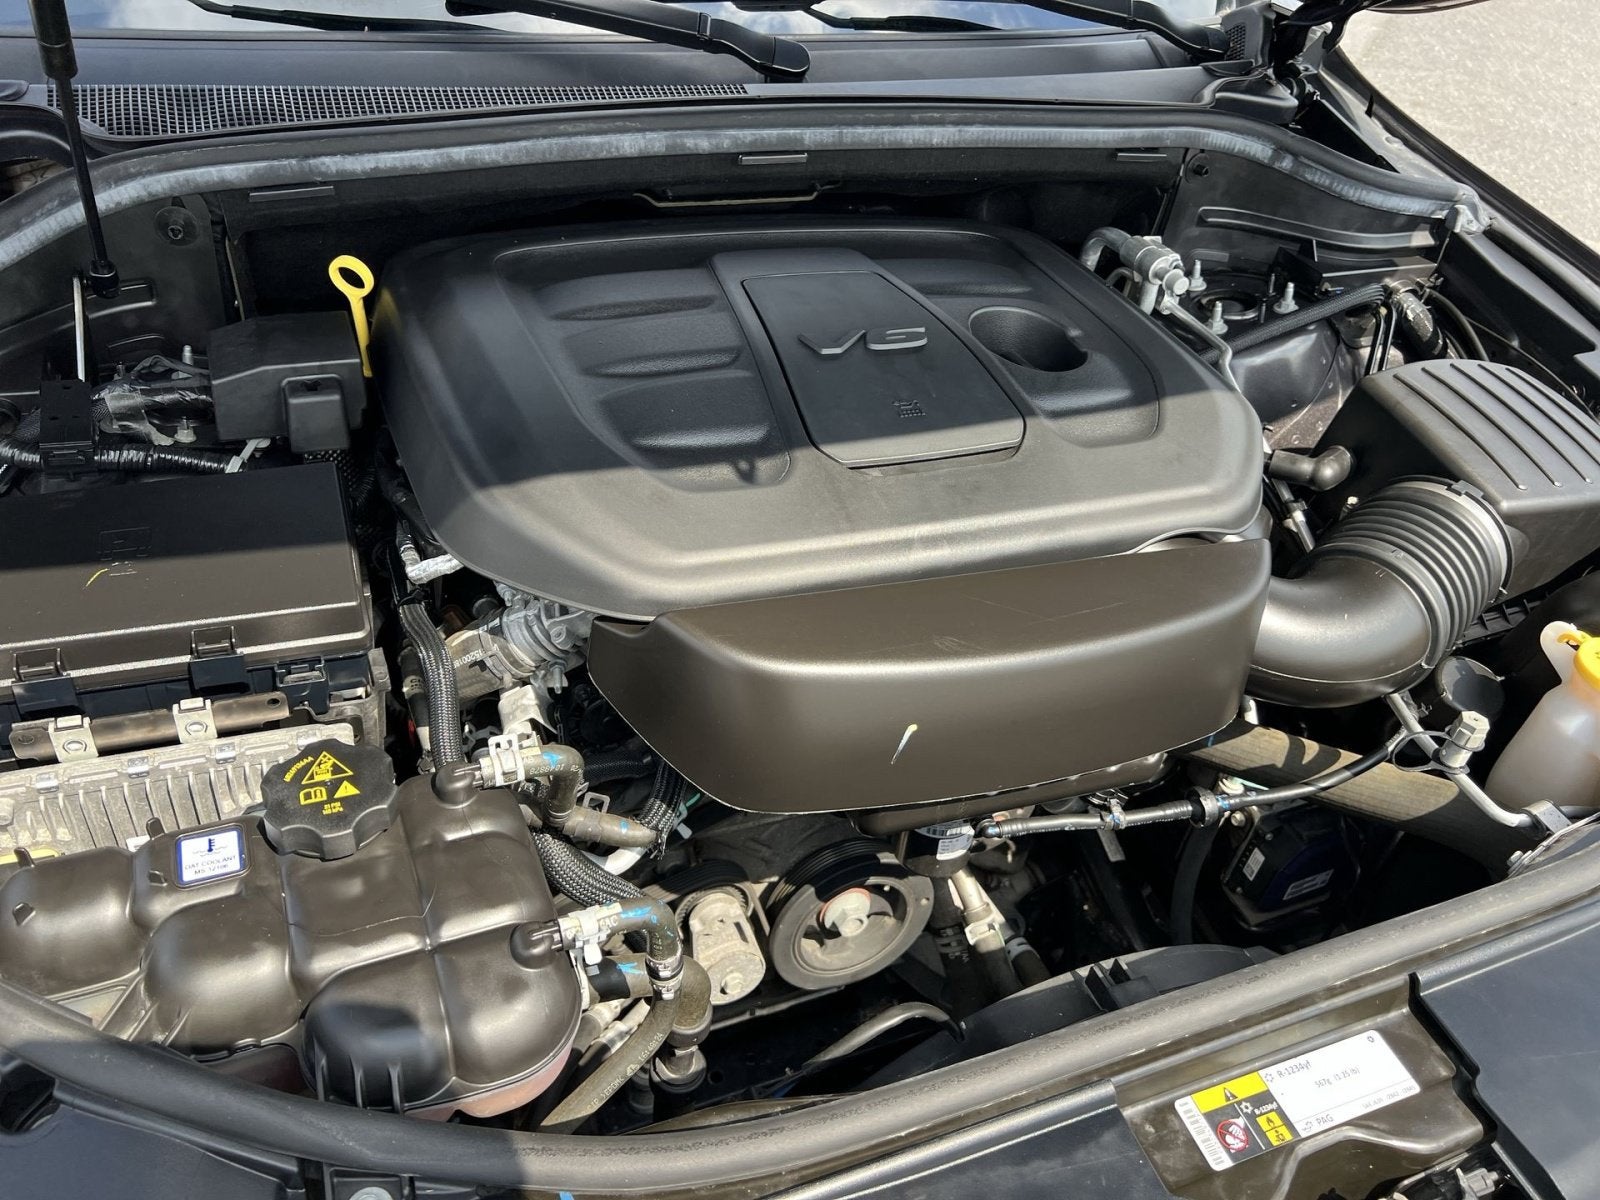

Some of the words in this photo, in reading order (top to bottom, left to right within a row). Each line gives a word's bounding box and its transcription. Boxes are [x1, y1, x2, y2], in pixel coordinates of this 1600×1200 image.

[797, 327, 928, 355] V6
[1276, 1060, 1312, 1079] R-1234yf
[1316, 1113, 1334, 1126] PAG
